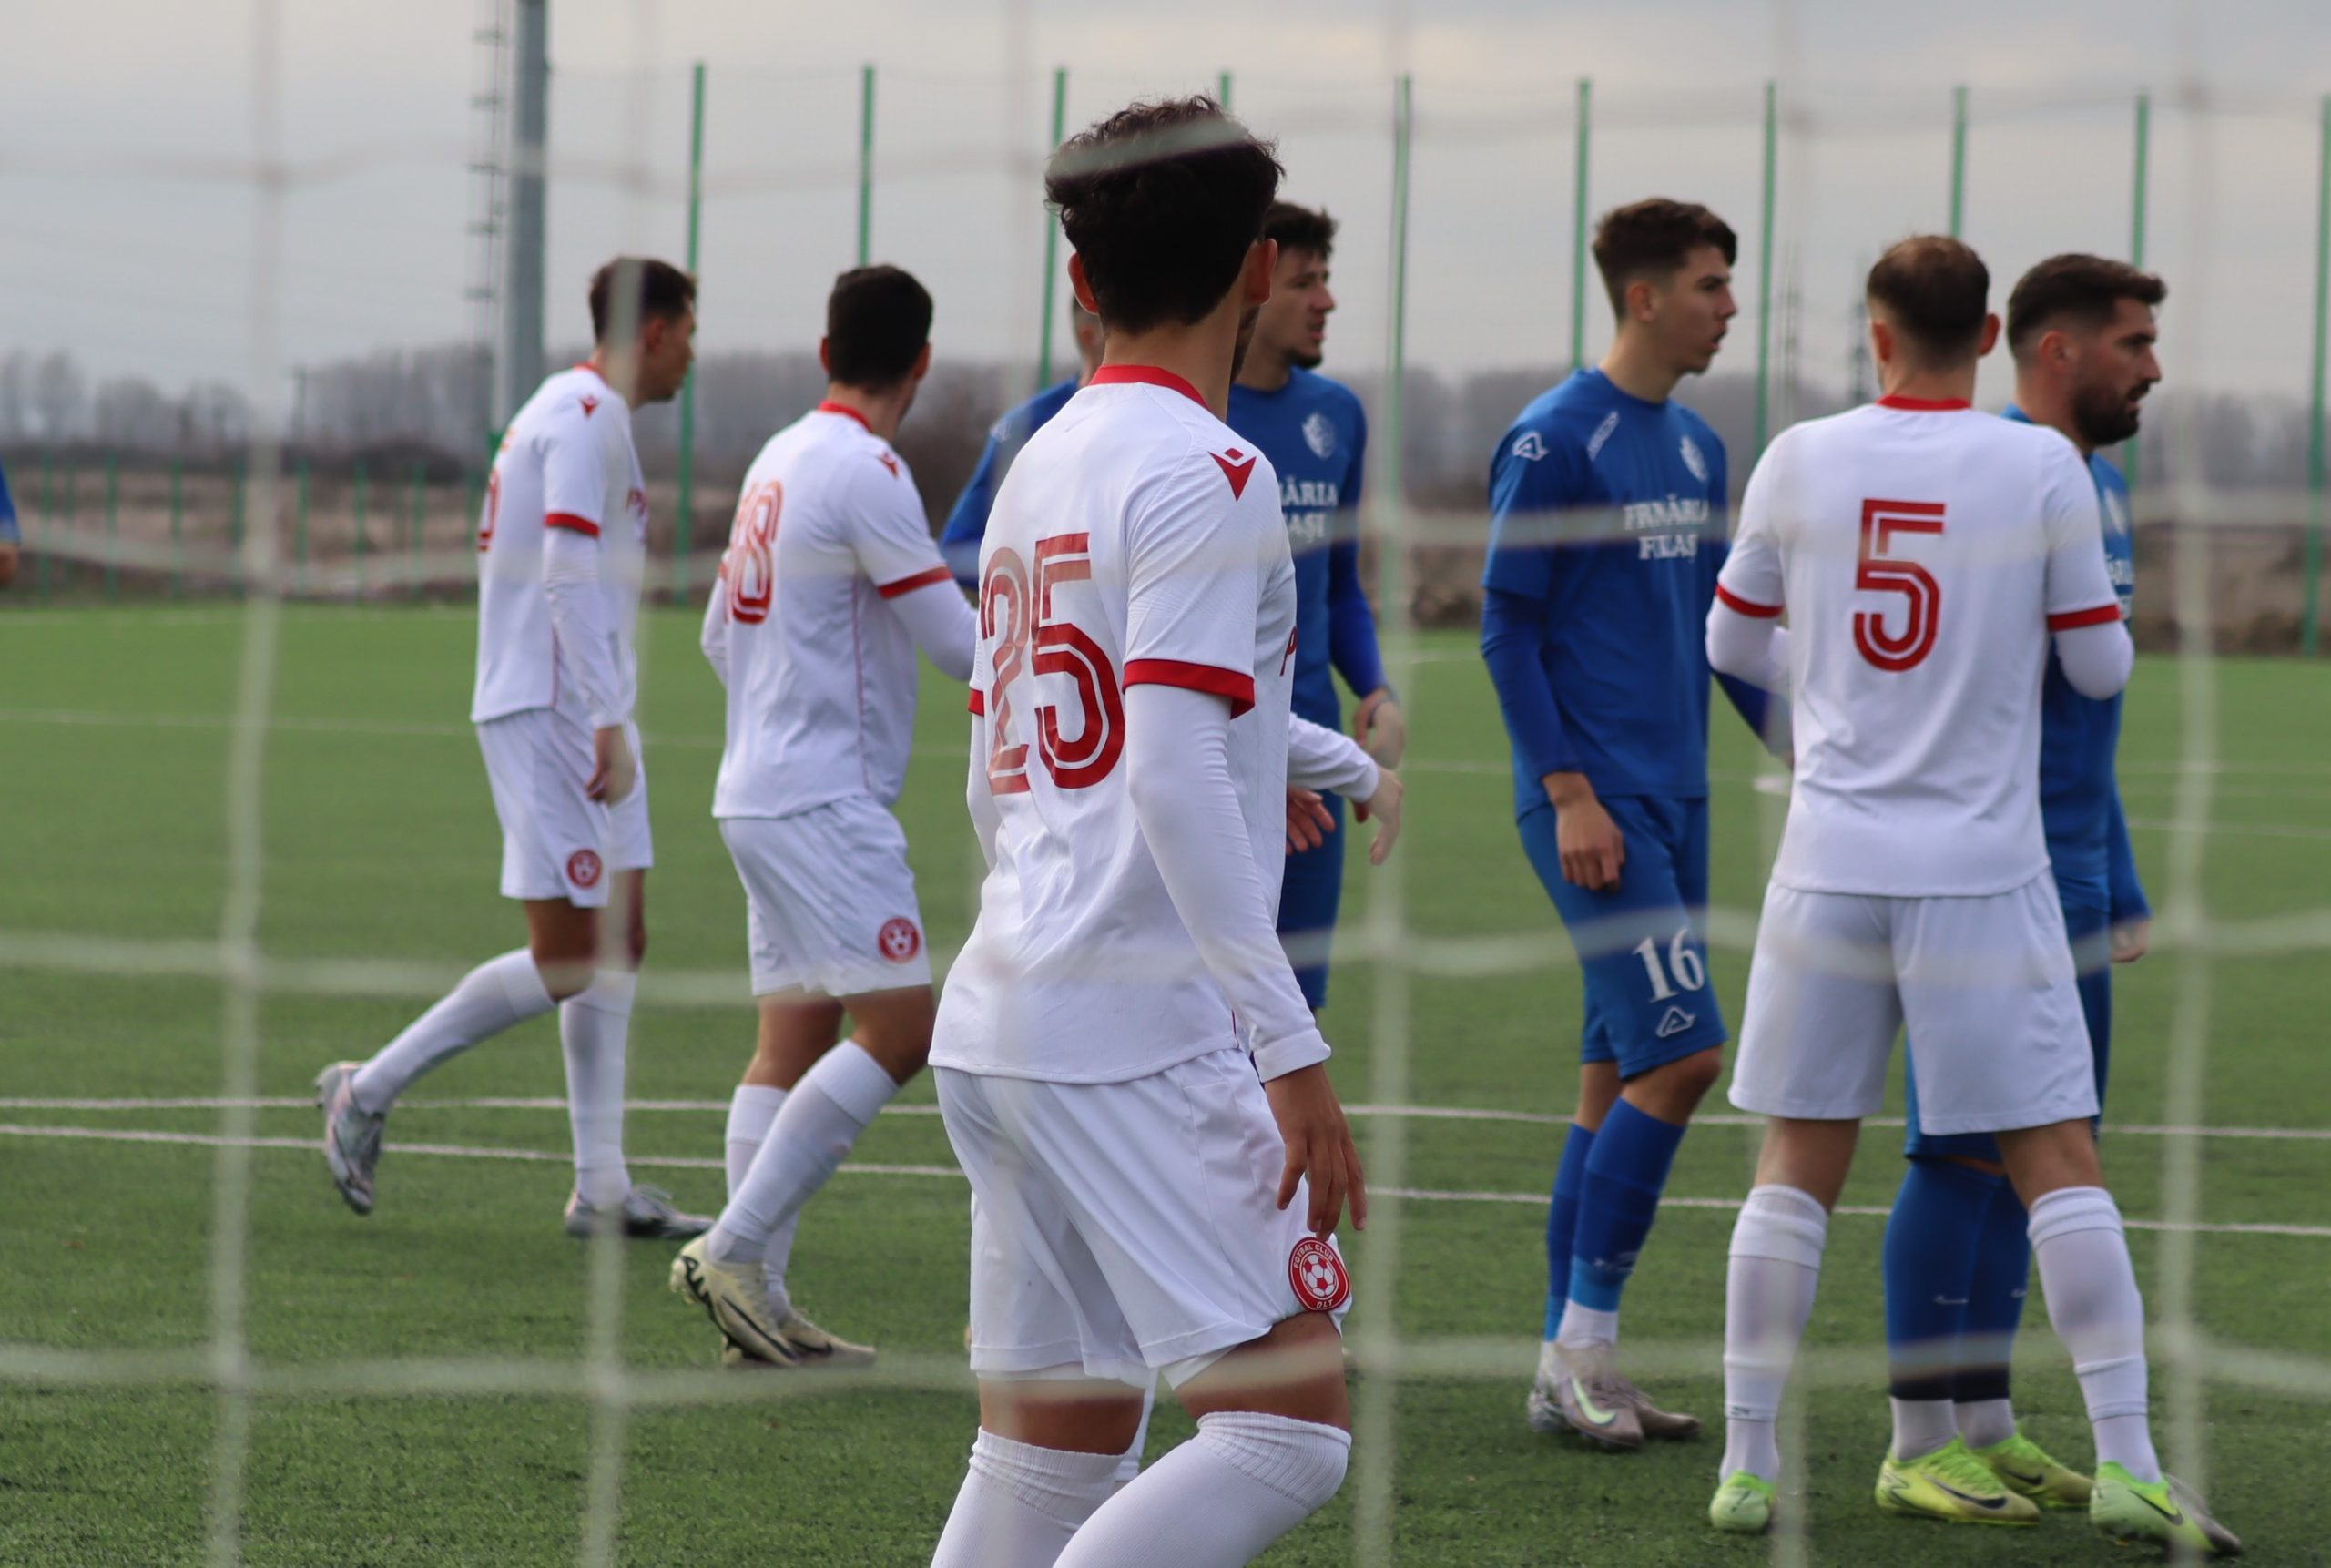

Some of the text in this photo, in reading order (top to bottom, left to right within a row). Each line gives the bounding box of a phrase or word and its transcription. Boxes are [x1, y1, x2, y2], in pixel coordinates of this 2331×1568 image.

[725, 480, 783, 626] 8
[1854, 498, 1947, 673] 5
[980, 532, 1125, 796] 25
[1633, 927, 1705, 1003] 16
[1294, 1244, 1333, 1268] FOTBAL CLUB
